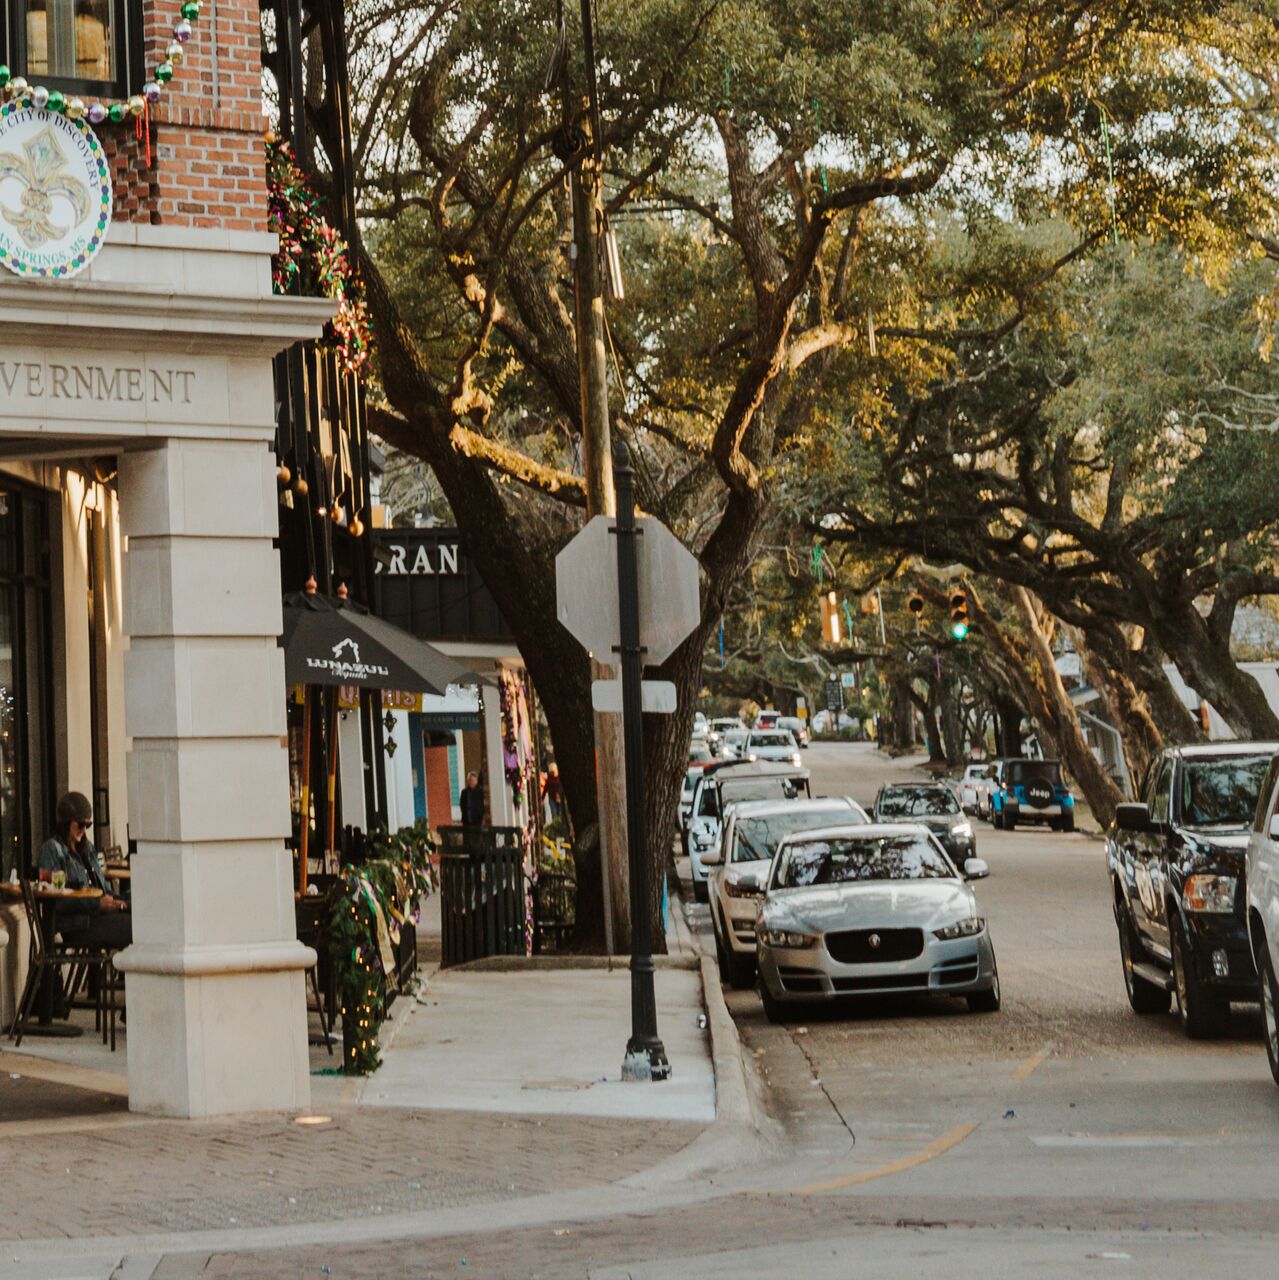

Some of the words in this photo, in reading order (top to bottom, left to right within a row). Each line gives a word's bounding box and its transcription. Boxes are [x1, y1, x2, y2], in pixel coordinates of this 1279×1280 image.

[7, 110, 34, 129] CITY
[37, 111, 52, 123] OF
[54, 114, 99, 191] DISCOVERY
[71, 235, 86, 255] MS
[374, 544, 458, 574] RAN
[1030, 787, 1050, 799] Jeep
